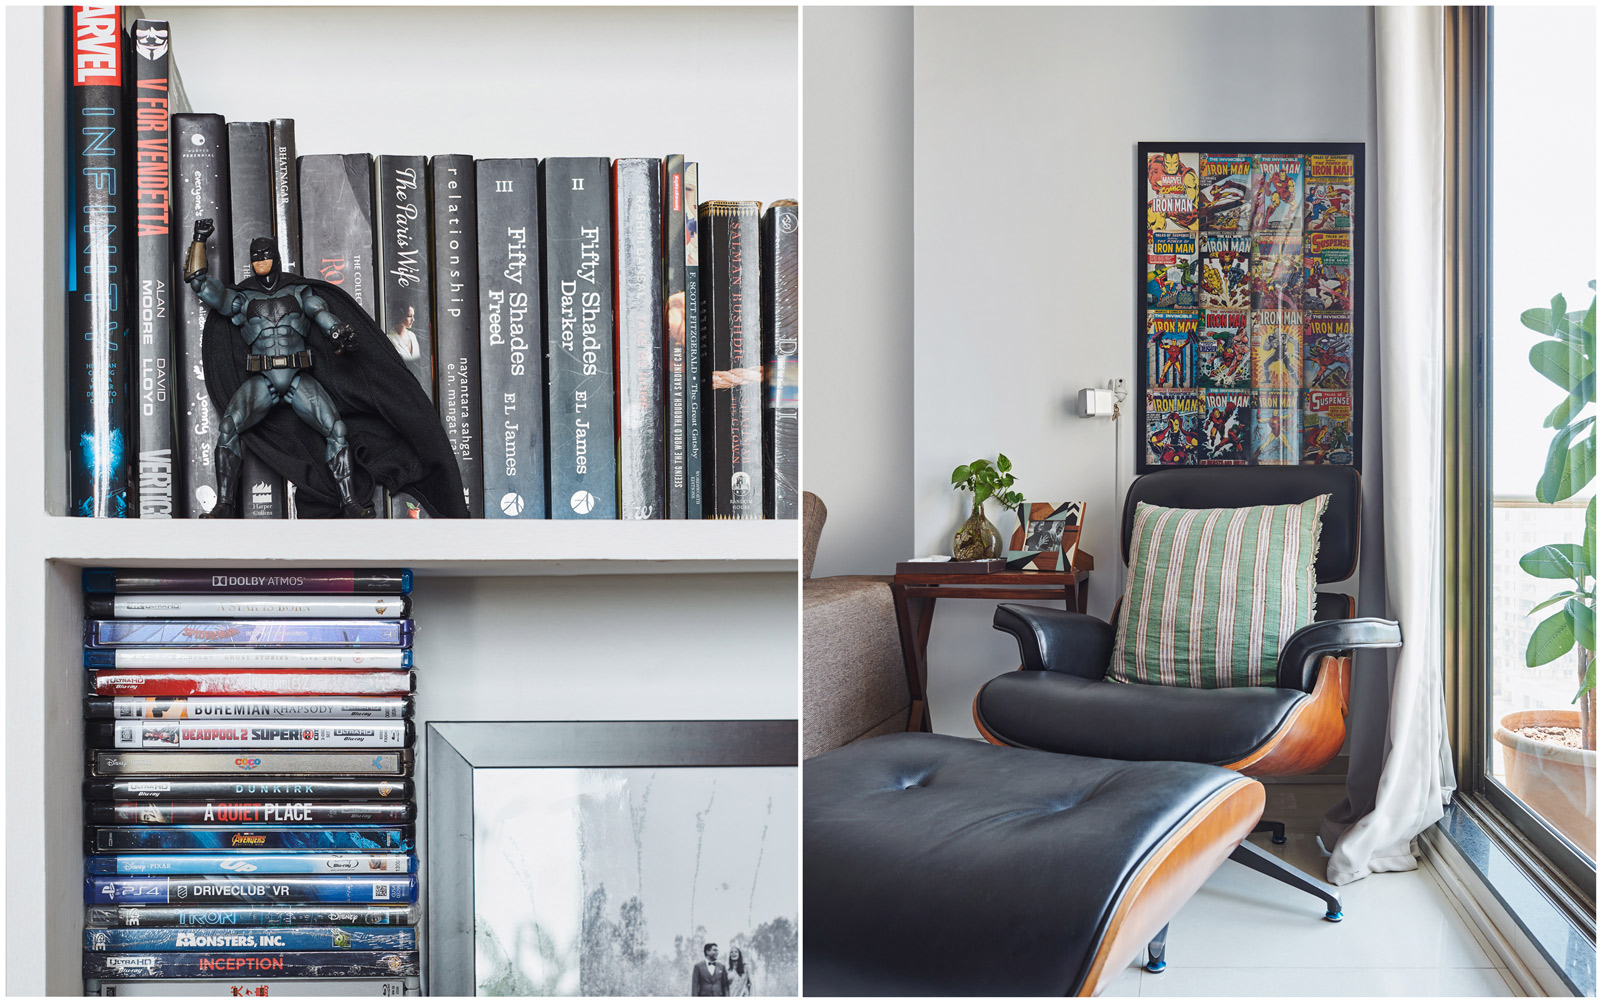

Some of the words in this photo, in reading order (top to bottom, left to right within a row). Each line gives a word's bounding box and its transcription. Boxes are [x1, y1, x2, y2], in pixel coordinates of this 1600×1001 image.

[137, 78, 168, 92] V
[137, 97, 168, 132] FOR
[279, 146, 290, 204] BHATNAGAR
[1207, 161, 1229, 176] IRON
[1230, 161, 1250, 176] MAN
[1260, 161, 1280, 174] IRON
[1281, 161, 1301, 174] MAN
[1312, 165, 1332, 176] IRON
[1333, 165, 1353, 176] MAN
[137, 138, 169, 237] VENDETTA
[396, 167, 418, 202] The
[496, 180, 514, 193] III
[572, 178, 585, 191] II
[1160, 185, 1185, 194] COMICS
[1161, 176, 1183, 185] MARVEL
[191, 170, 204, 217] everyone's
[1152, 198, 1173, 213] IRON
[1174, 198, 1193, 213] MAN
[396, 203, 418, 249] Paris
[636, 195, 646, 244] RASHMI
[448, 168, 465, 318] relationship
[1154, 243, 1174, 254] IRON
[1175, 243, 1195, 254] MAN
[1207, 238, 1229, 253] IRON
[1230, 238, 1252, 253] MAN
[1312, 234, 1350, 252] SUSPENSE
[353, 254, 361, 270] THE
[503, 226, 527, 285] Fifty
[576, 225, 600, 285] Fifty
[731, 222, 743, 286] SALMAN
[243, 264, 251, 279] THE
[390, 249, 421, 288] Wife
[637, 247, 648, 300] BANSAL
[689, 271, 697, 279] F.
[156, 279, 166, 318] ALAN
[689, 281, 697, 313] SCOTT
[142, 279, 153, 345] MOORE
[488, 289, 505, 346] Freed
[560, 279, 577, 351] Darker
[1206, 313, 1228, 328] IRON
[1228, 313, 1247, 328] MAN
[1261, 311, 1281, 325] IRON
[1283, 311, 1303, 325] MAN
[509, 292, 529, 376] Shades
[581, 292, 601, 376] Shades
[732, 293, 744, 364] RUSHDIE
[1153, 318, 1176, 333] IRON
[1177, 318, 1198, 333] MAN
[1311, 320, 1333, 334] IRON
[1335, 320, 1354, 334] MAN
[689, 315, 699, 374] FITZGERALD
[156, 358, 166, 402] DAVID
[447, 363, 456, 386] e.n.
[673, 362, 682, 390] SARDINE
[142, 358, 154, 417] LLOYD
[457, 357, 469, 419] nayantara
[638, 371, 649, 410] HOME
[691, 383, 699, 401] The
[1152, 395, 1175, 412] IRON
[1177, 395, 1198, 412] MAN
[1206, 393, 1228, 408] IRON
[1229, 393, 1250, 408] MAN
[1259, 395, 1278, 408] IRON
[1311, 392, 1350, 410] SUSPENSE
[446, 389, 458, 435] mangat
[674, 398, 682, 427] THROUGH
[691, 402, 699, 427] Great
[459, 422, 473, 461] sahgal
[504, 421, 519, 476] James
[575, 419, 590, 474] James
[674, 428, 683, 450] WORLD
[690, 428, 700, 459] Gatsby
[731, 418, 740, 464] CLOWN
[674, 451, 682, 464] THE
[139, 449, 172, 519] VERTIG
[674, 464, 683, 488] SEEING
[229, 576, 265, 585] DOLBY
[267, 576, 304, 585] ATMOS
[182, 627, 240, 640] SPIDER-MAN
[195, 705, 270, 715] BOHEMIAN
[273, 705, 334, 716] RHAPSODY
[182, 728, 239, 741] DEADPOOL
[241, 728, 248, 741] 2
[251, 728, 301, 741] SUPER
[235, 785, 314, 793] DUNKIRK
[204, 803, 214, 821] A
[217, 803, 262, 821] QUIET
[264, 803, 313, 821] PLACE
[122, 861, 146, 872] Disney
[219, 859, 258, 873] UP
[122, 886, 160, 896] PS4
[272, 885, 290, 896] VR
[178, 909, 236, 925] TRON
[328, 911, 359, 924] Disney
[260, 936, 286, 946] INC.
[200, 957, 283, 970] INCEPTION
